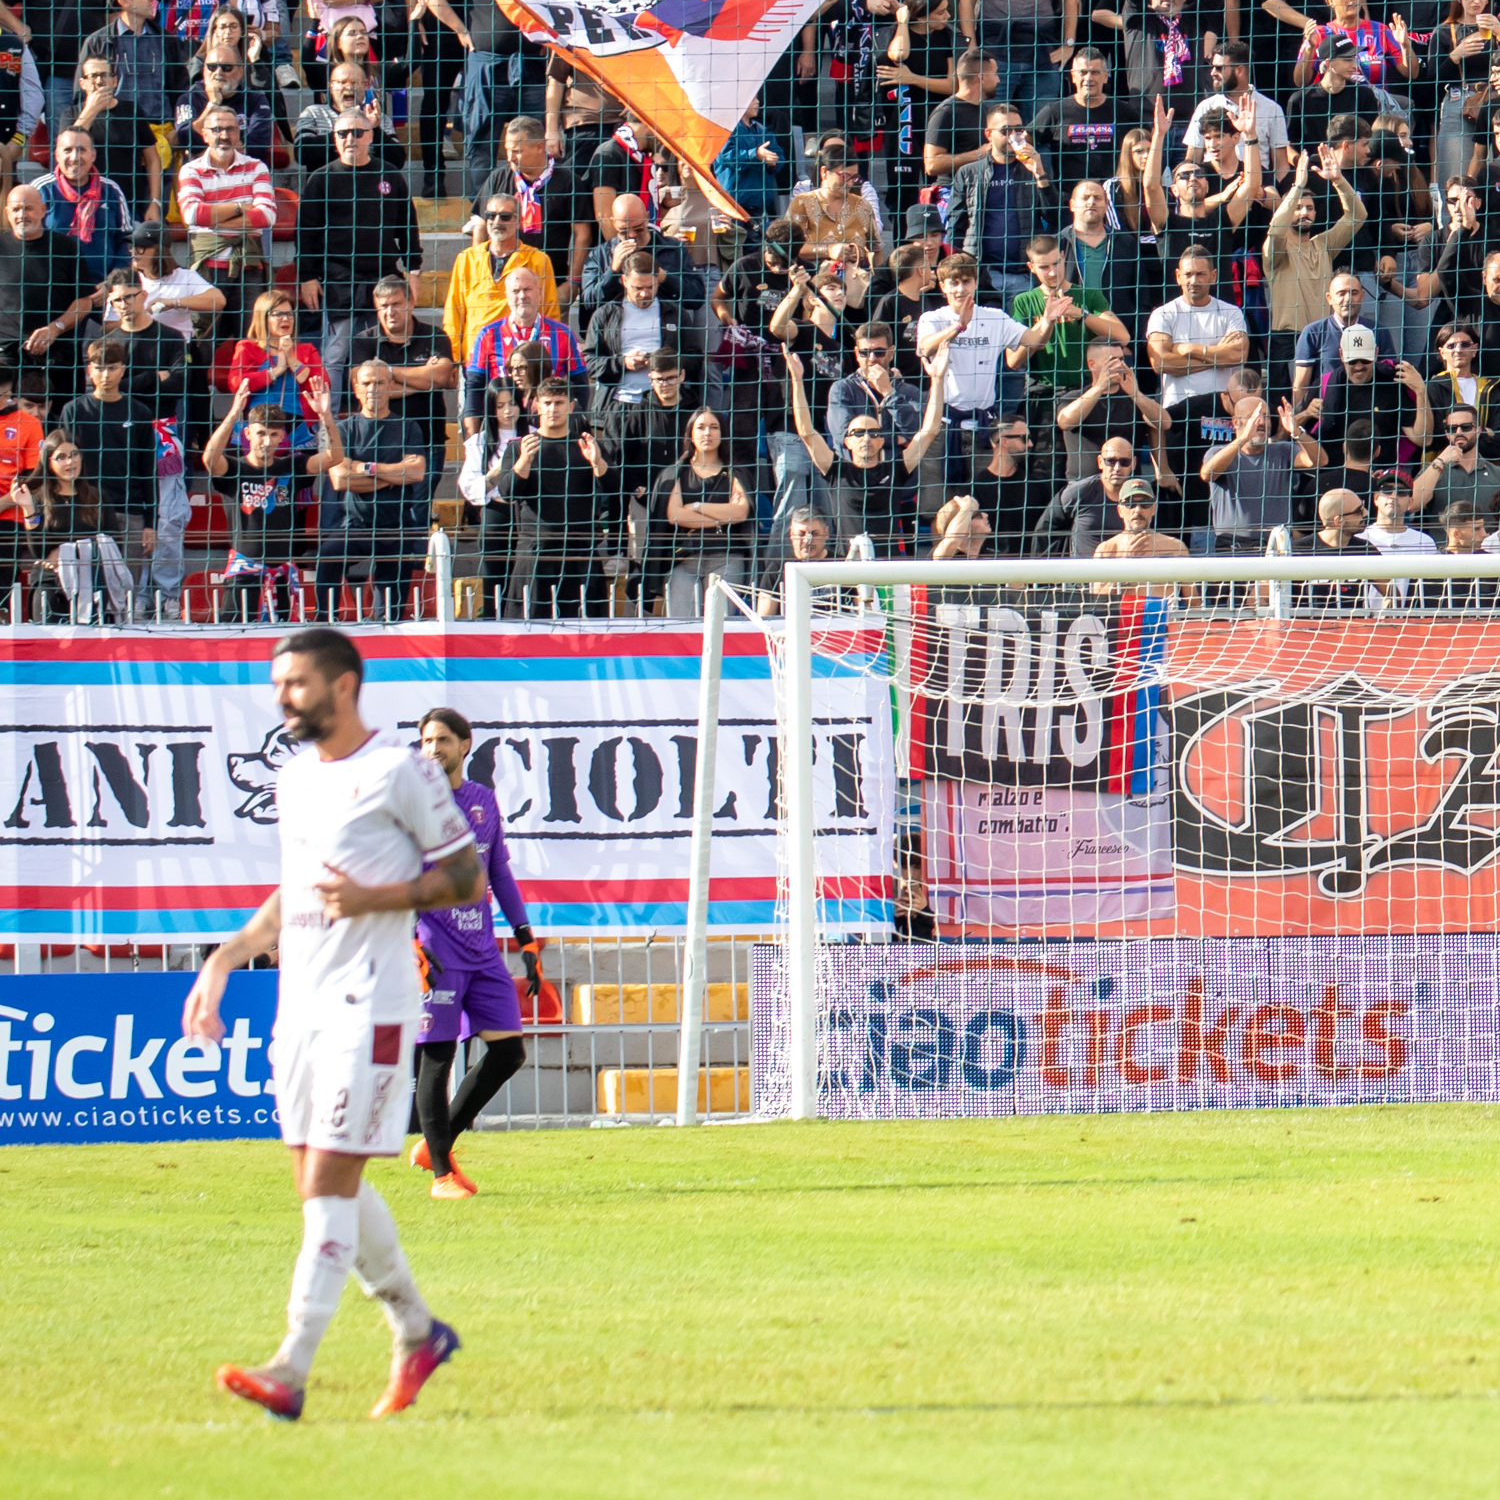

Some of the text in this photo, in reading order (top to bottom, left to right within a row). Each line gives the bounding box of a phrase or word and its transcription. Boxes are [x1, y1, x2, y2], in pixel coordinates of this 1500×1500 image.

[241, 481, 273, 498] CUSP
[243, 493, 269, 508] 1980
[466, 732, 873, 826] CIOLTI
[818, 974, 1409, 1092] iaotickets
[0, 1106, 279, 1128] www.ciaotickets.co
